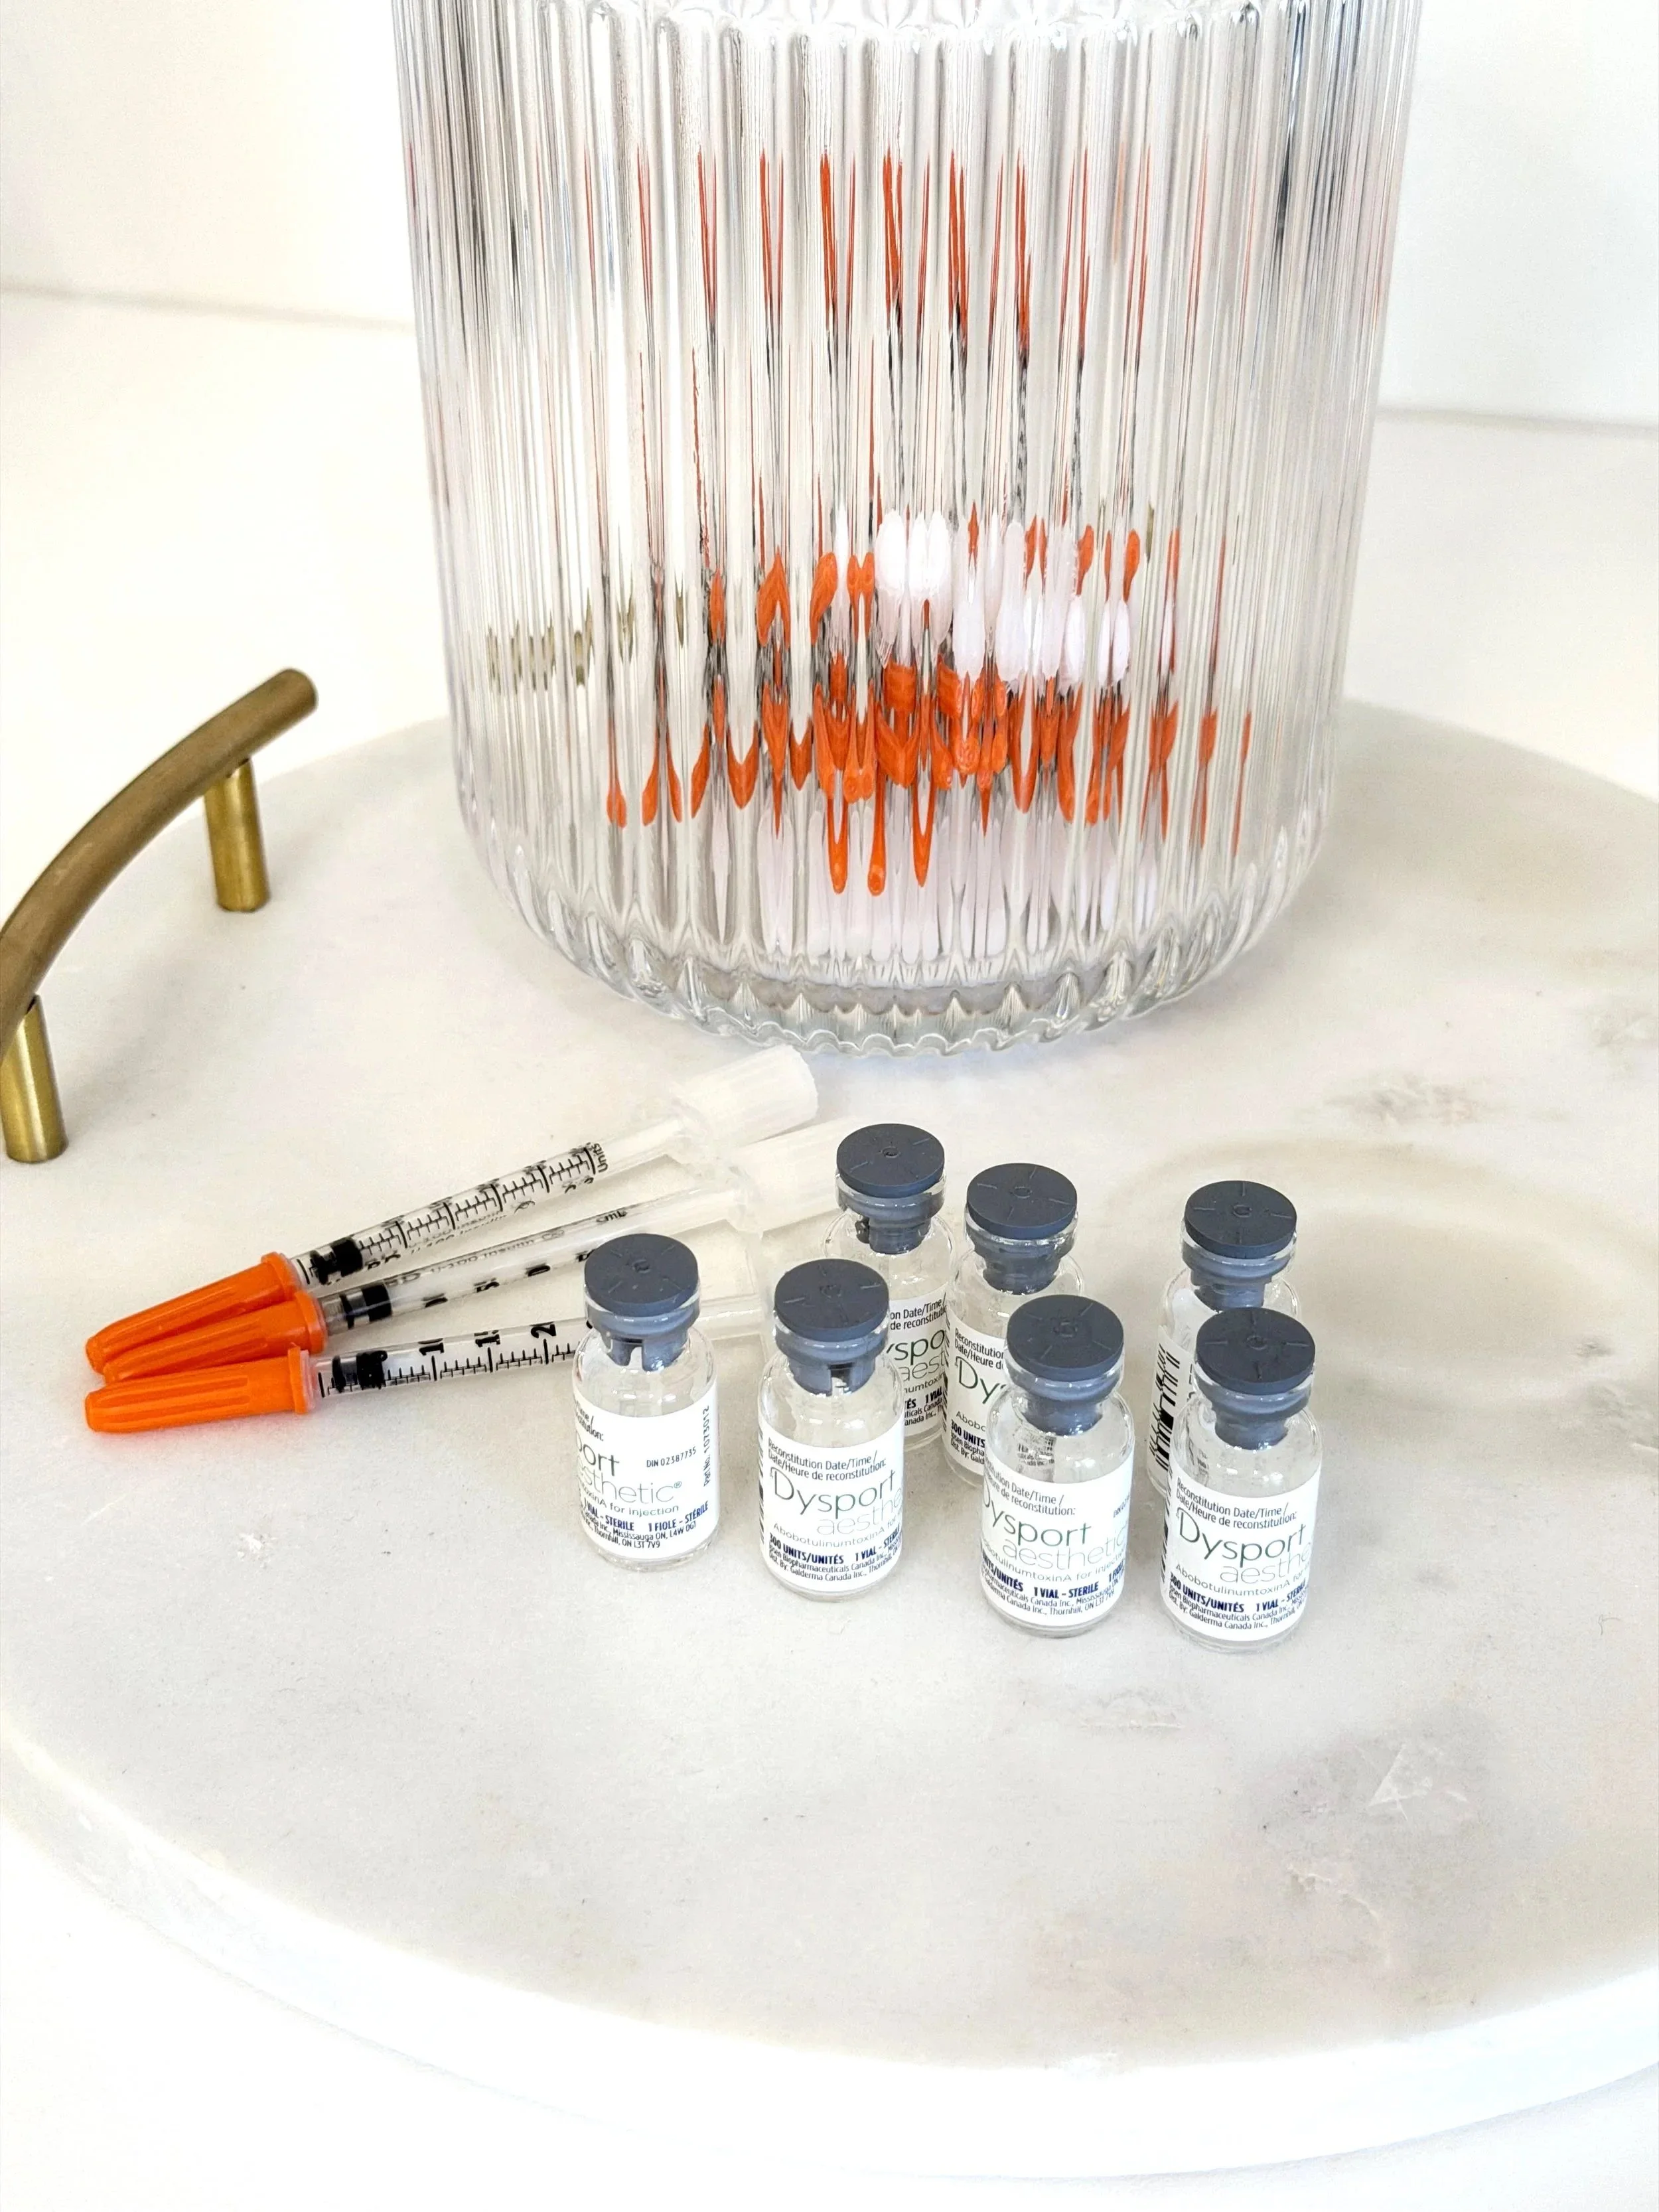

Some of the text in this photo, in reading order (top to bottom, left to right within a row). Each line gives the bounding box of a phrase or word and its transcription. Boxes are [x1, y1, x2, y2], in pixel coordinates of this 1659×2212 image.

[890, 1321, 901, 1330] de
[660, 1445, 696, 1466] 02387735
[768, 1437, 823, 1469] Reconstitution
[826, 1455, 871, 1471] Date/Time
[812, 1471, 823, 1481] de
[770, 1467, 895, 1519] Dysport
[1001, 1488, 1009, 1500] de
[1011, 1495, 1076, 1516] reconstitution:
[1011, 1482, 1056, 1504] Date/Time
[1177, 1477, 1231, 1516] Reconstitution
[1234, 1507, 1282, 1519] Date/Time
[610, 1503, 625, 1514] for
[1176, 1489, 1297, 1529] Date/Heure de reconstitution:
[605, 1515, 634, 1531] STERILE
[648, 1522, 652, 1532] 1
[654, 1518, 677, 1532] FIOLE
[613, 1527, 654, 1542] Mississauga
[670, 1526, 684, 1538] L4W
[622, 1538, 632, 1547] ON
[774, 1522, 885, 1548] AbobotulinumtoxinA
[1176, 1507, 1306, 1568] Dysport
[783, 1543, 844, 1565] UNITS/UNITÉS
[855, 1552, 859, 1562] 1
[861, 1546, 877, 1560] VIAL
[783, 1553, 849, 1573] Biopharmaceuticals
[851, 1558, 875, 1570] Canada
[790, 1566, 823, 1581] Galderma
[825, 1573, 851, 1582] Canada
[1076, 1572, 1092, 1580] for
[1176, 1563, 1290, 1596] AbobotulinumtoxinA
[1034, 1587, 1038, 1597] 1
[1040, 1587, 1059, 1599] VIAL
[1068, 1581, 1099, 1598] STERILE
[1183, 1584, 1244, 1613] UNITS/UNITÉS
[1256, 1603, 1260, 1612] 1
[1262, 1598, 1279, 1611] VIAL
[1007, 1595, 1031, 1611] Canada
[1050, 1606, 1082, 1615] Thornhill,
[1031, 1596, 1057, 1607] Canada
[1183, 1595, 1250, 1621] Biopharmaceuticals
[1252, 1609, 1277, 1621] Canada
[1189, 1609, 1222, 1627] Galderma
[1224, 1621, 1252, 1629] Canada
